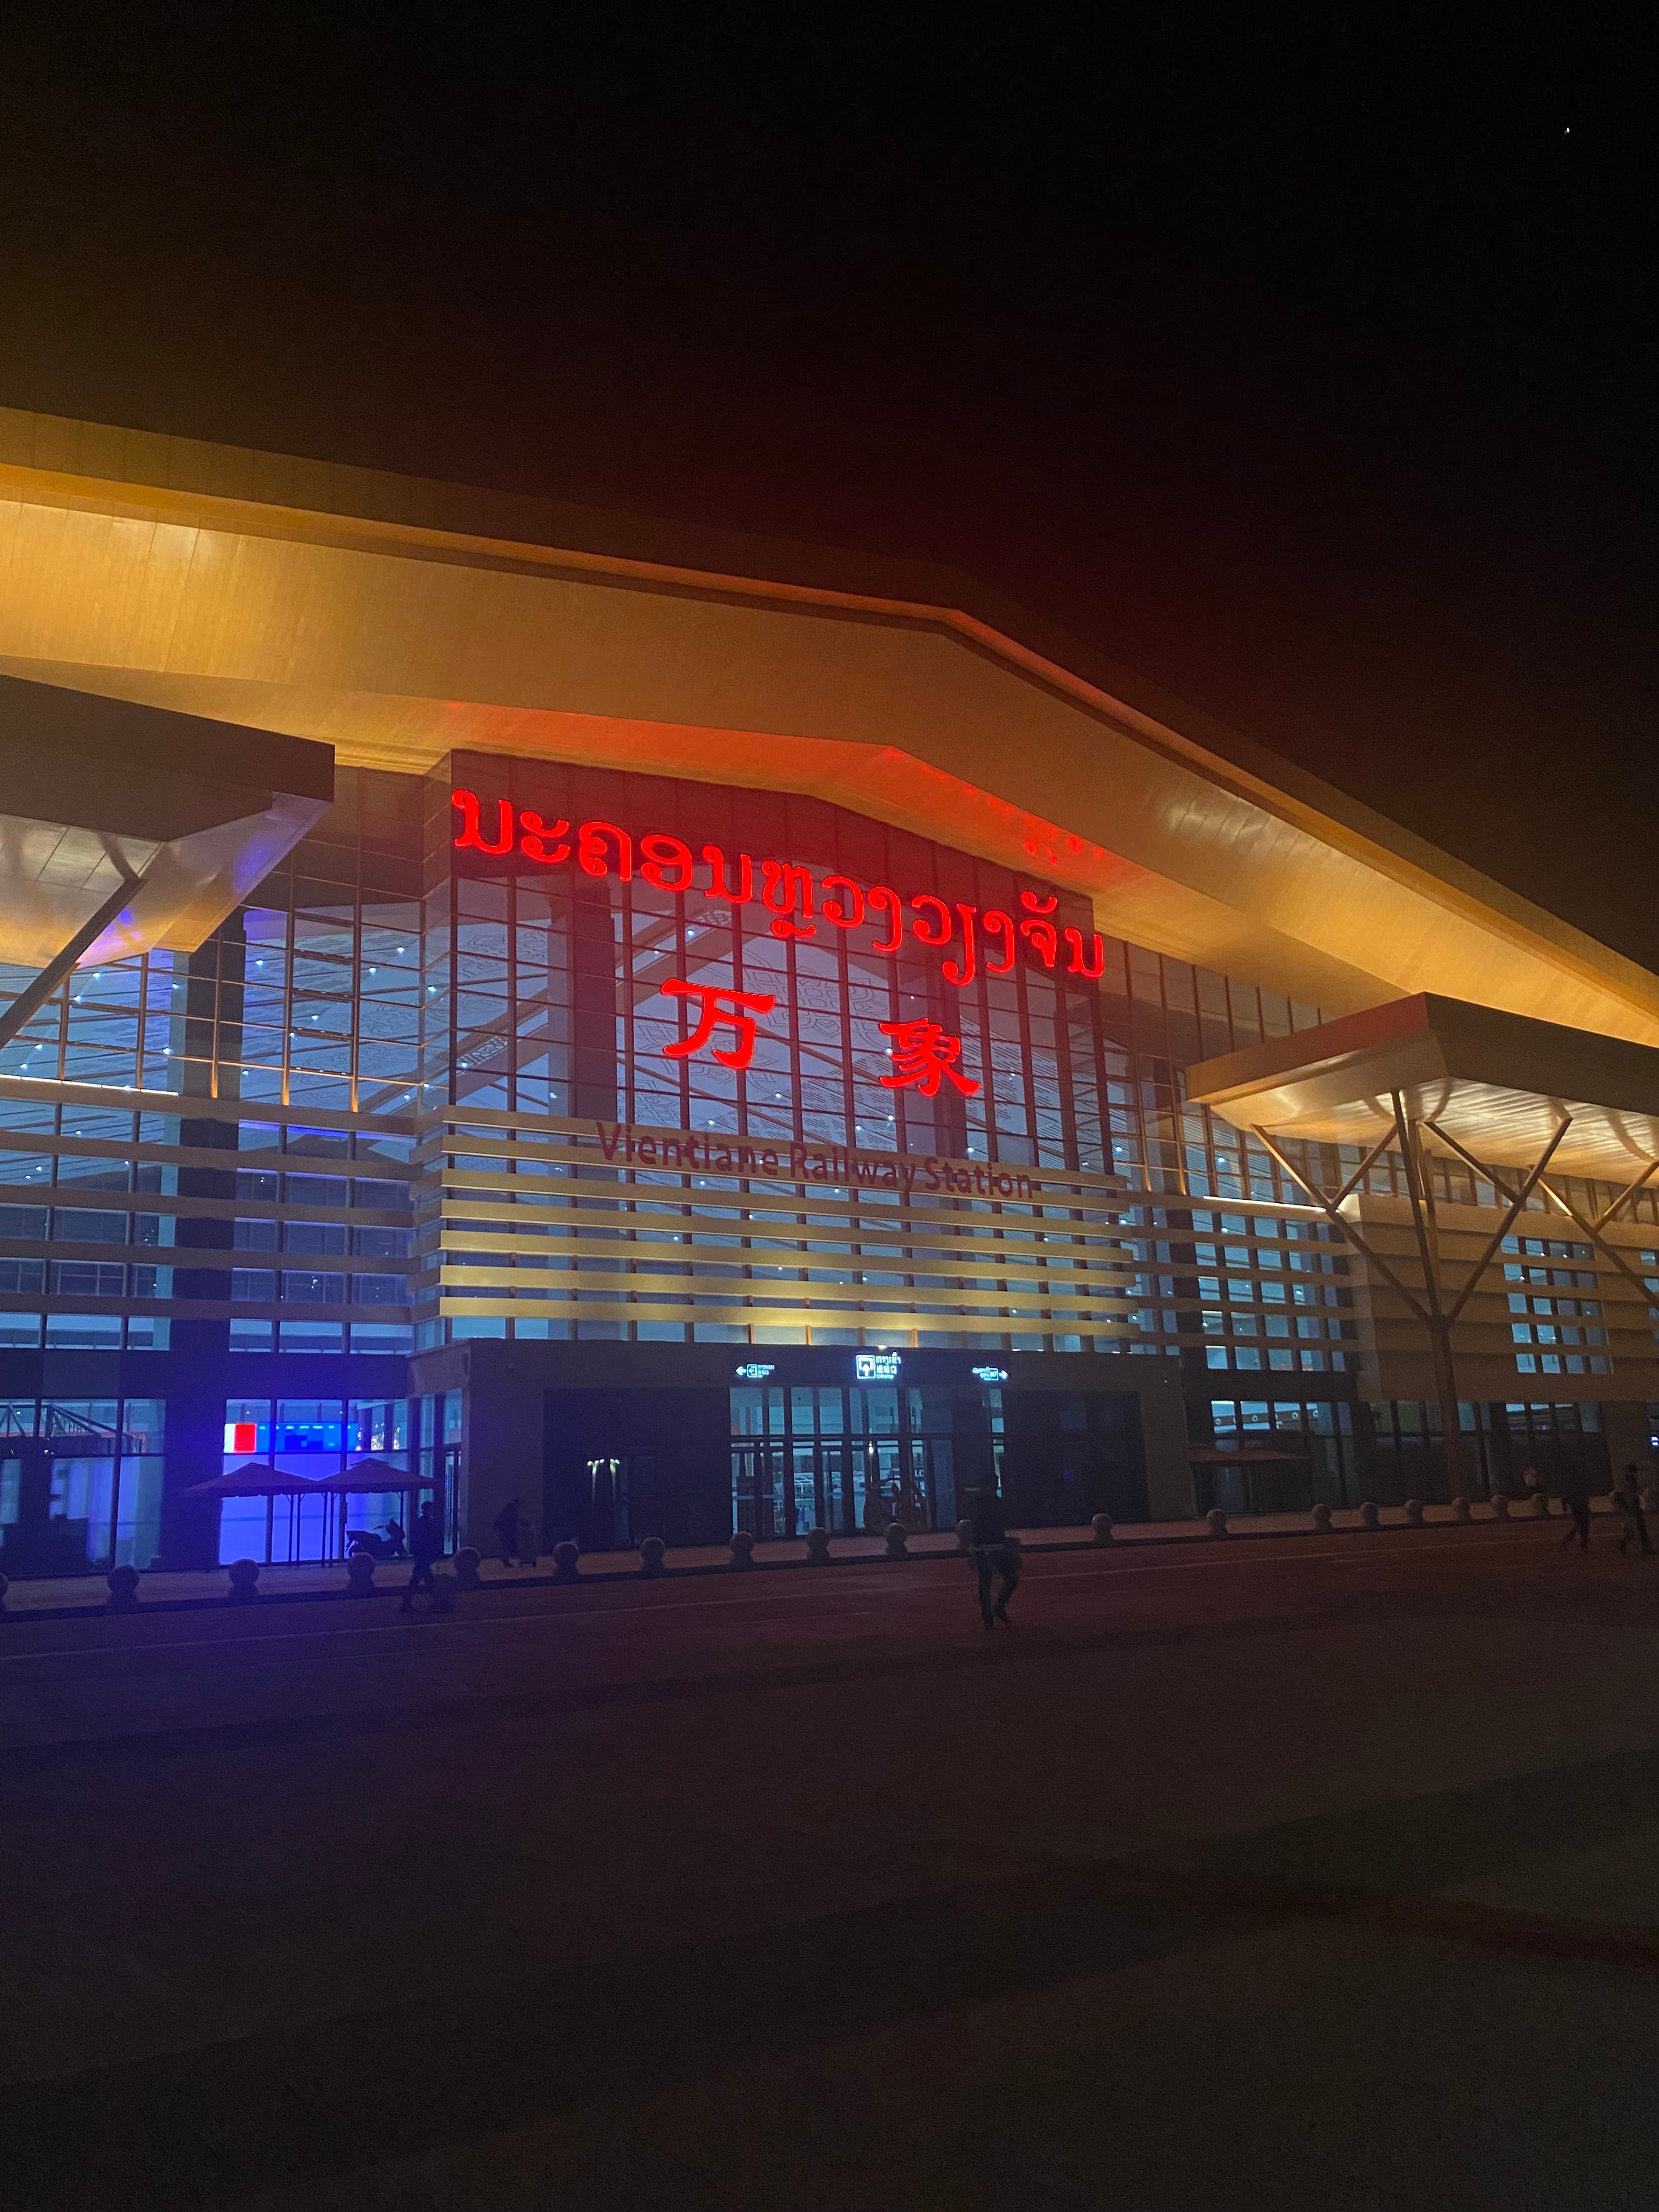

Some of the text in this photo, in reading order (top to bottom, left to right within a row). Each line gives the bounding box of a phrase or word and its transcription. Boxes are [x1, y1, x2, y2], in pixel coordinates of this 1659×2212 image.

[660, 977, 981, 1097] 万象
[596, 1121, 1033, 1199] Vientiane Railway Station
